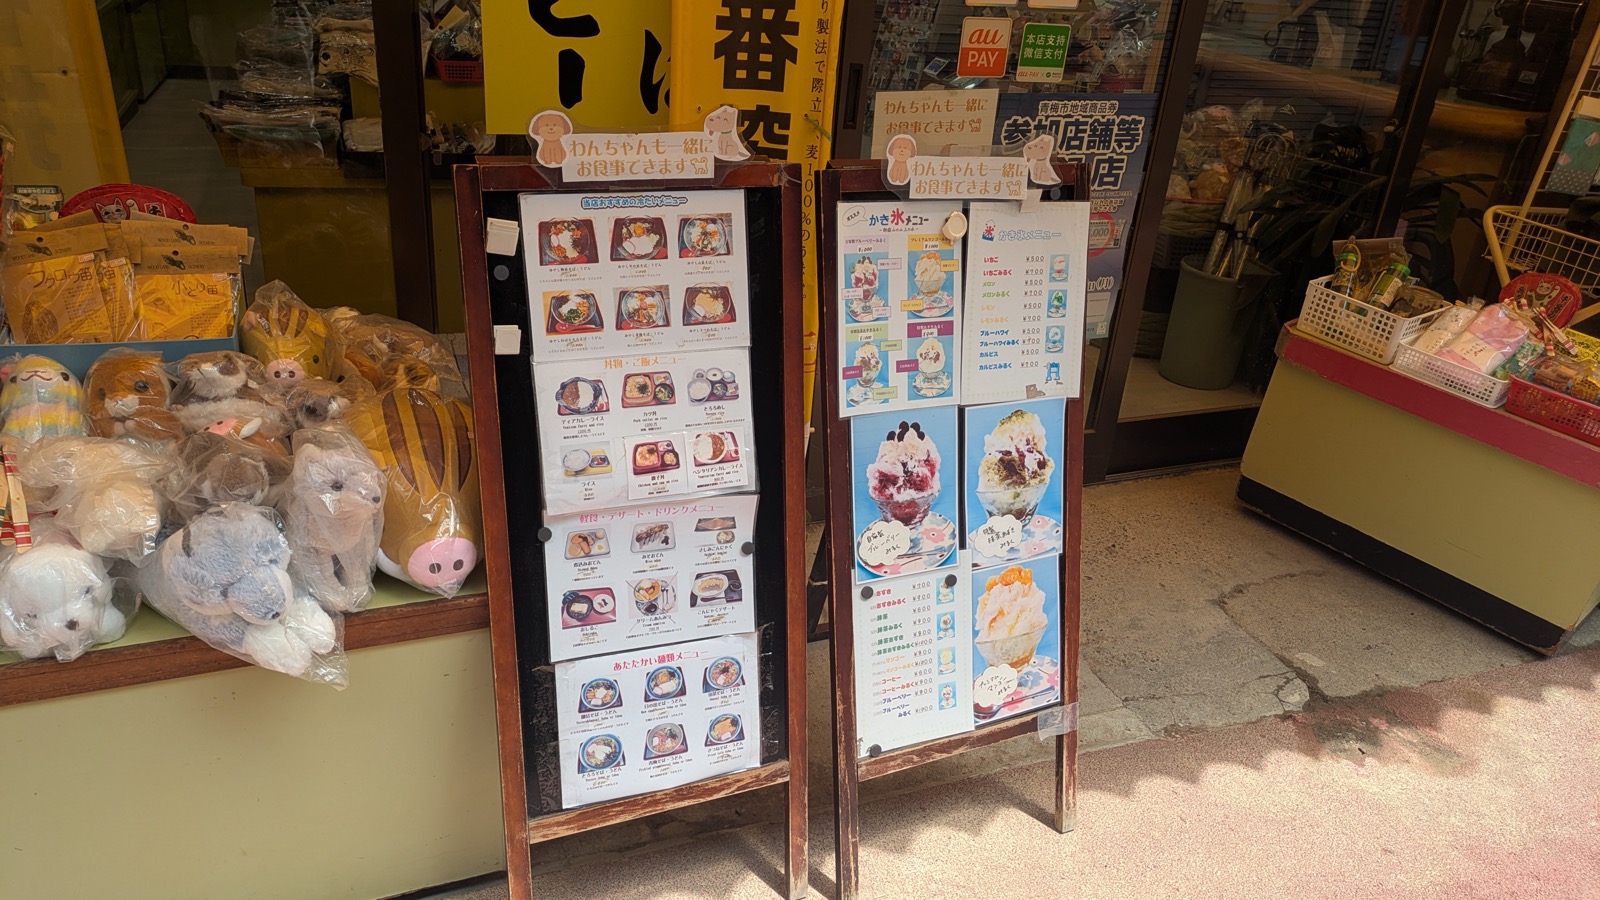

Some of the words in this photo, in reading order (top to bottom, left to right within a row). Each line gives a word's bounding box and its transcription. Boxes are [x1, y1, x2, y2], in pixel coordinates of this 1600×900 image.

[968, 27, 1003, 45] au
[1026, 33, 1066, 46] 本店支持
[967, 51, 999, 68] PAY
[1023, 47, 1063, 60] 微信支付
[883, 98, 988, 115] わんちゃんも一緒に
[1039, 101, 1119, 115] 青梅市地域商品券
[886, 118, 968, 135] お食事できます
[569, 136, 715, 157] わんちゃんも一緒に
[577, 159, 688, 177] お食事できます
[912, 161, 1028, 178] わんちゃんも一緒に
[915, 180, 1001, 196] お食事できます
[582, 196, 687, 209] 当店おすすめの冷たいメニュー
[868, 208, 930, 227] かき氷メニュー
[998, 229, 1062, 241] かき氷メニュー
[984, 256, 999, 264] いちご
[980, 316, 1009, 324] レモンみるく
[980, 329, 1010, 337] ブルーハワイ
[979, 338, 1020, 347] ブルーハワイみるく
[979, 350, 999, 358] カルピス
[603, 356, 687, 370] 丼物・ご飯メニュー
[978, 362, 1013, 371] カルピスみるく
[561, 416, 605, 425] ディアカレーライス
[579, 505, 724, 523] 軽食・デザート・ドリンクメニュー
[867, 533, 900, 553] ブルーベリー
[876, 597, 906, 609] あずきみるく
[613, 650, 709, 672] あたたかい麺類メニュー
[885, 655, 906, 663] マンゴー
[881, 676, 902, 685] コーヒー
[881, 682, 915, 695] コーヒーみるく
[882, 693, 912, 704] ブルーベリー
[882, 703, 910, 714] ブルーベリー
[898, 709, 912, 718] みるく
